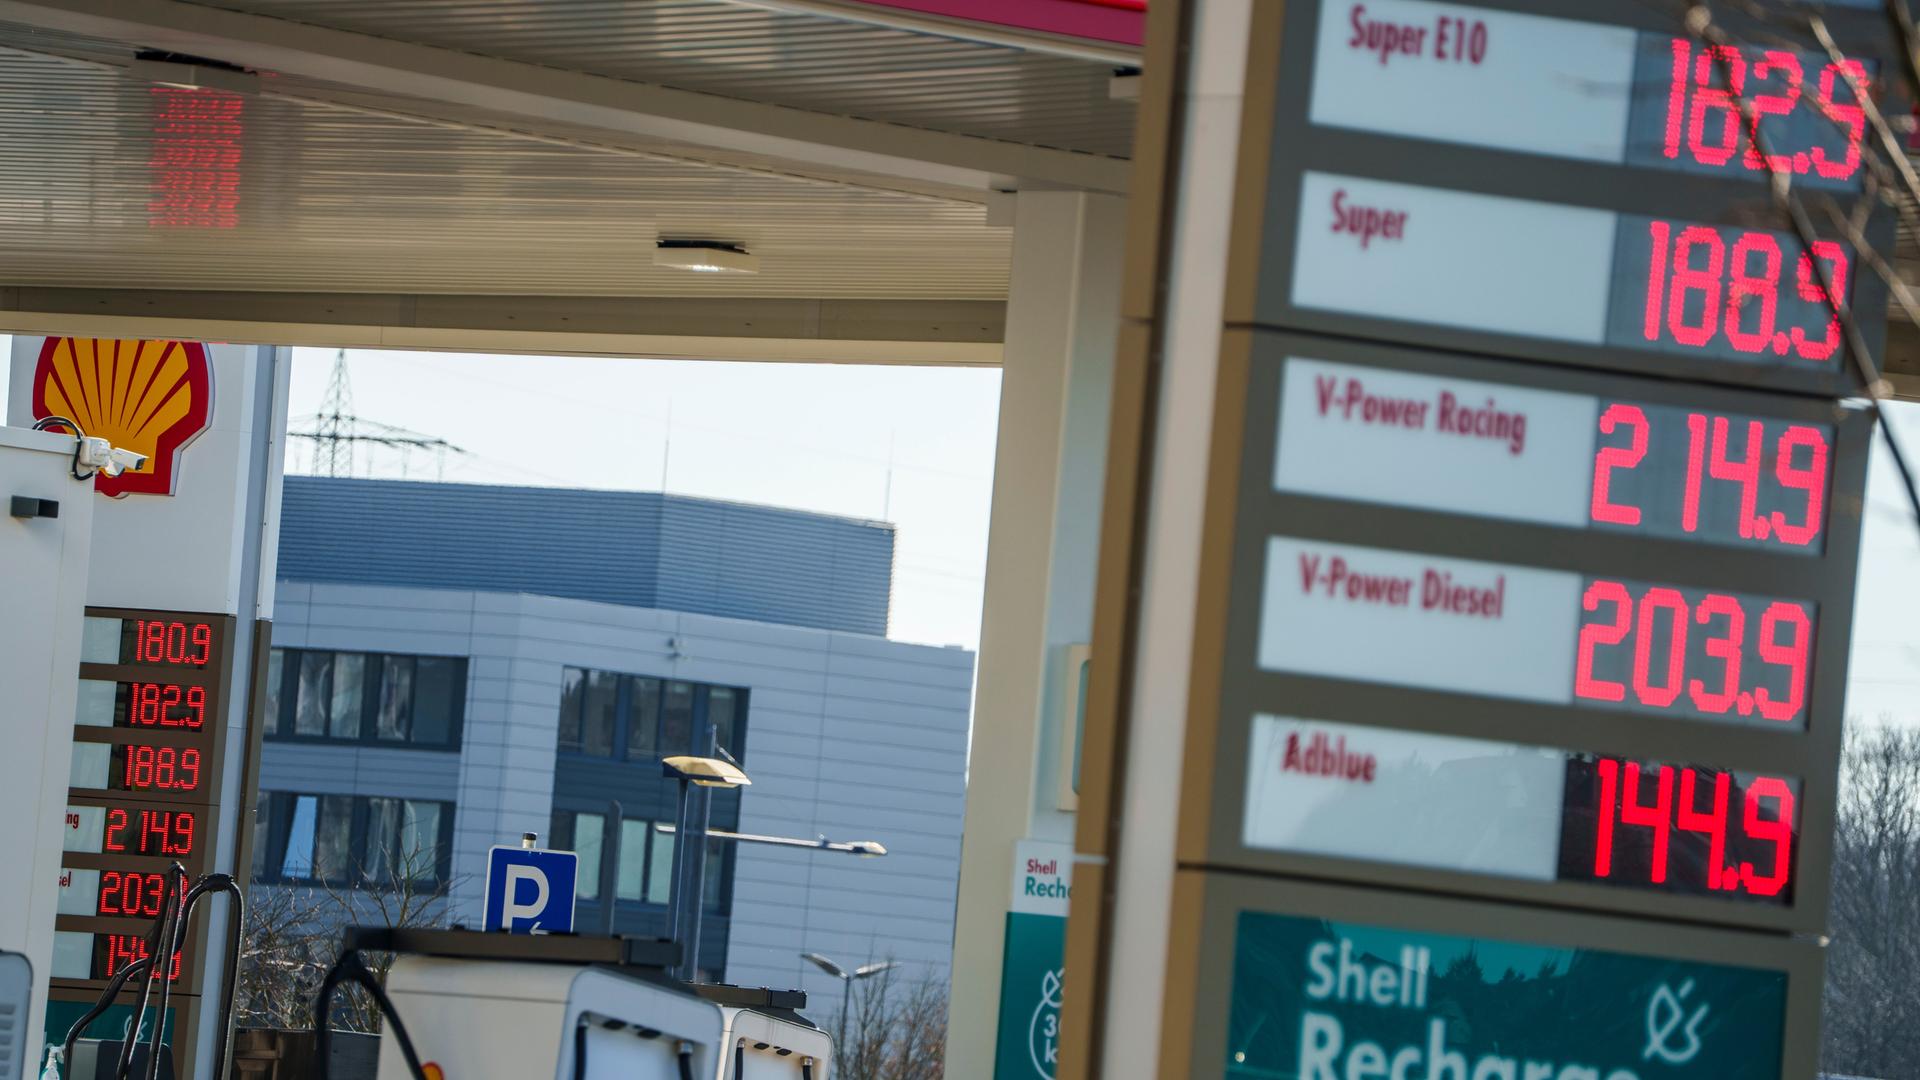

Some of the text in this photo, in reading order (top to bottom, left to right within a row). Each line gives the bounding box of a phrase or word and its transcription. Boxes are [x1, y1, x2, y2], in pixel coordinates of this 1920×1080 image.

[1350, 4, 1870, 180] Super E10 182.9
[1331, 190, 1848, 360] Super 188.9
[1316, 375, 1828, 545] V-Power Racing 214.9
[136, 619, 211, 665] 180.9
[1300, 553, 1810, 721] V-Power Diesel 203.9
[130, 682, 206, 728] 182.9
[125, 744, 200, 790] 188.9
[65, 808, 194, 854] ng 214.9
[1282, 732, 1795, 897] Adblue 144.9
[502, 863, 550, 935] P
[1027, 858, 1057, 875] Shell
[1306, 937, 1429, 1007] Shell
[1043, 1013, 1063, 1037] 3
